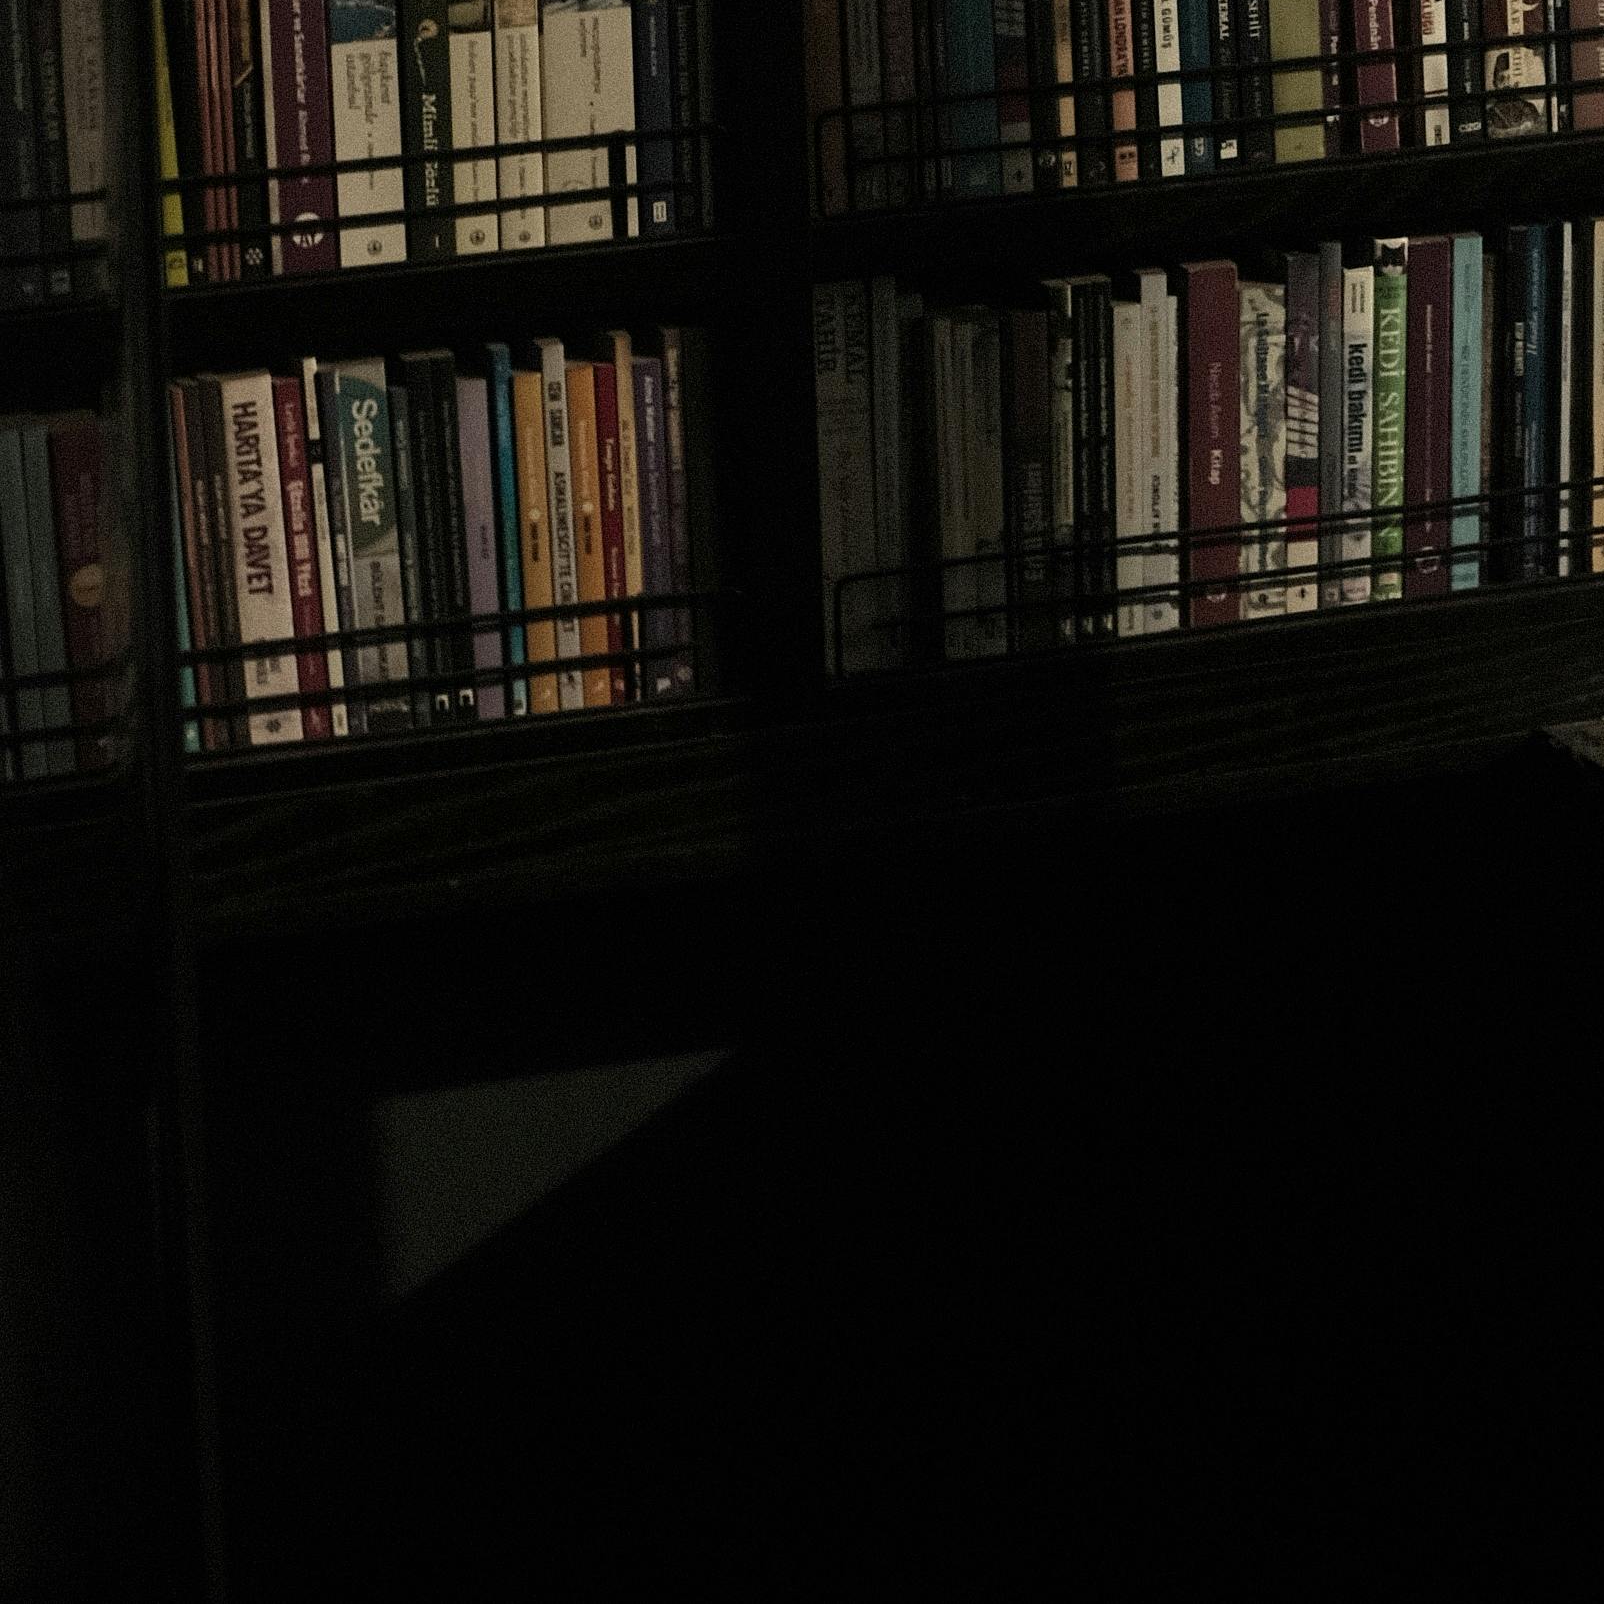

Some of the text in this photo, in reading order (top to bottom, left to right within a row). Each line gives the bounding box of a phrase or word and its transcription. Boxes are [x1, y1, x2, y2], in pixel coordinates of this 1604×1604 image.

[1347, 343, 1366, 384] kedi
[351, 398, 384, 527] Sedefkâr
[1208, 449, 1223, 485] Kitap
[1348, 391, 1367, 453] bakımı
[1377, 307, 1405, 537] KEDİ SAHİBİNN
[232, 401, 274, 595] HARİTA'YA DAVET
